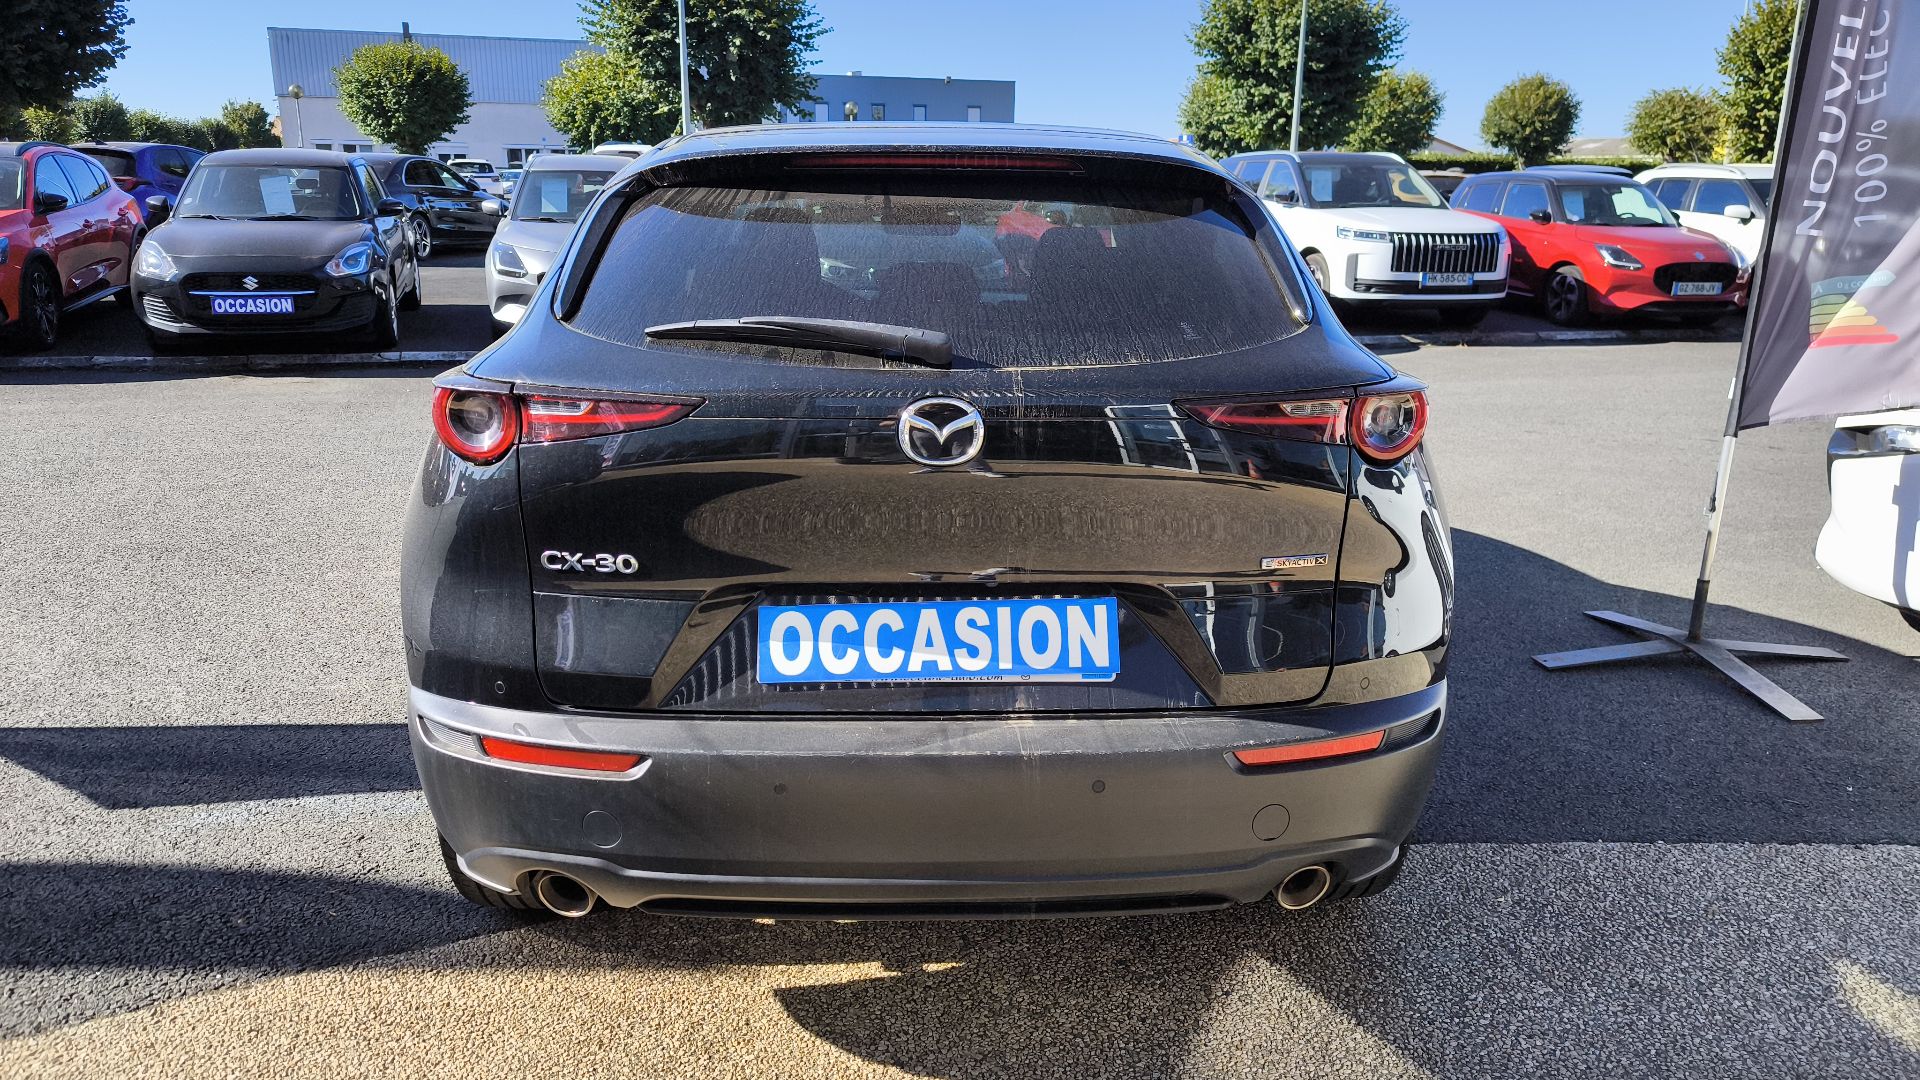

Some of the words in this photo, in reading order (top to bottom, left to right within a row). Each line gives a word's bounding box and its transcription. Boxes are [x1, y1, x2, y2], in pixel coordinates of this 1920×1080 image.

[1795, 0, 1867, 237] NOUVEL
[1854, 119, 1888, 228] 100%
[214, 298, 293, 313] OCCASION
[540, 550, 639, 575] CX-30
[769, 604, 1110, 676] OCCASION
